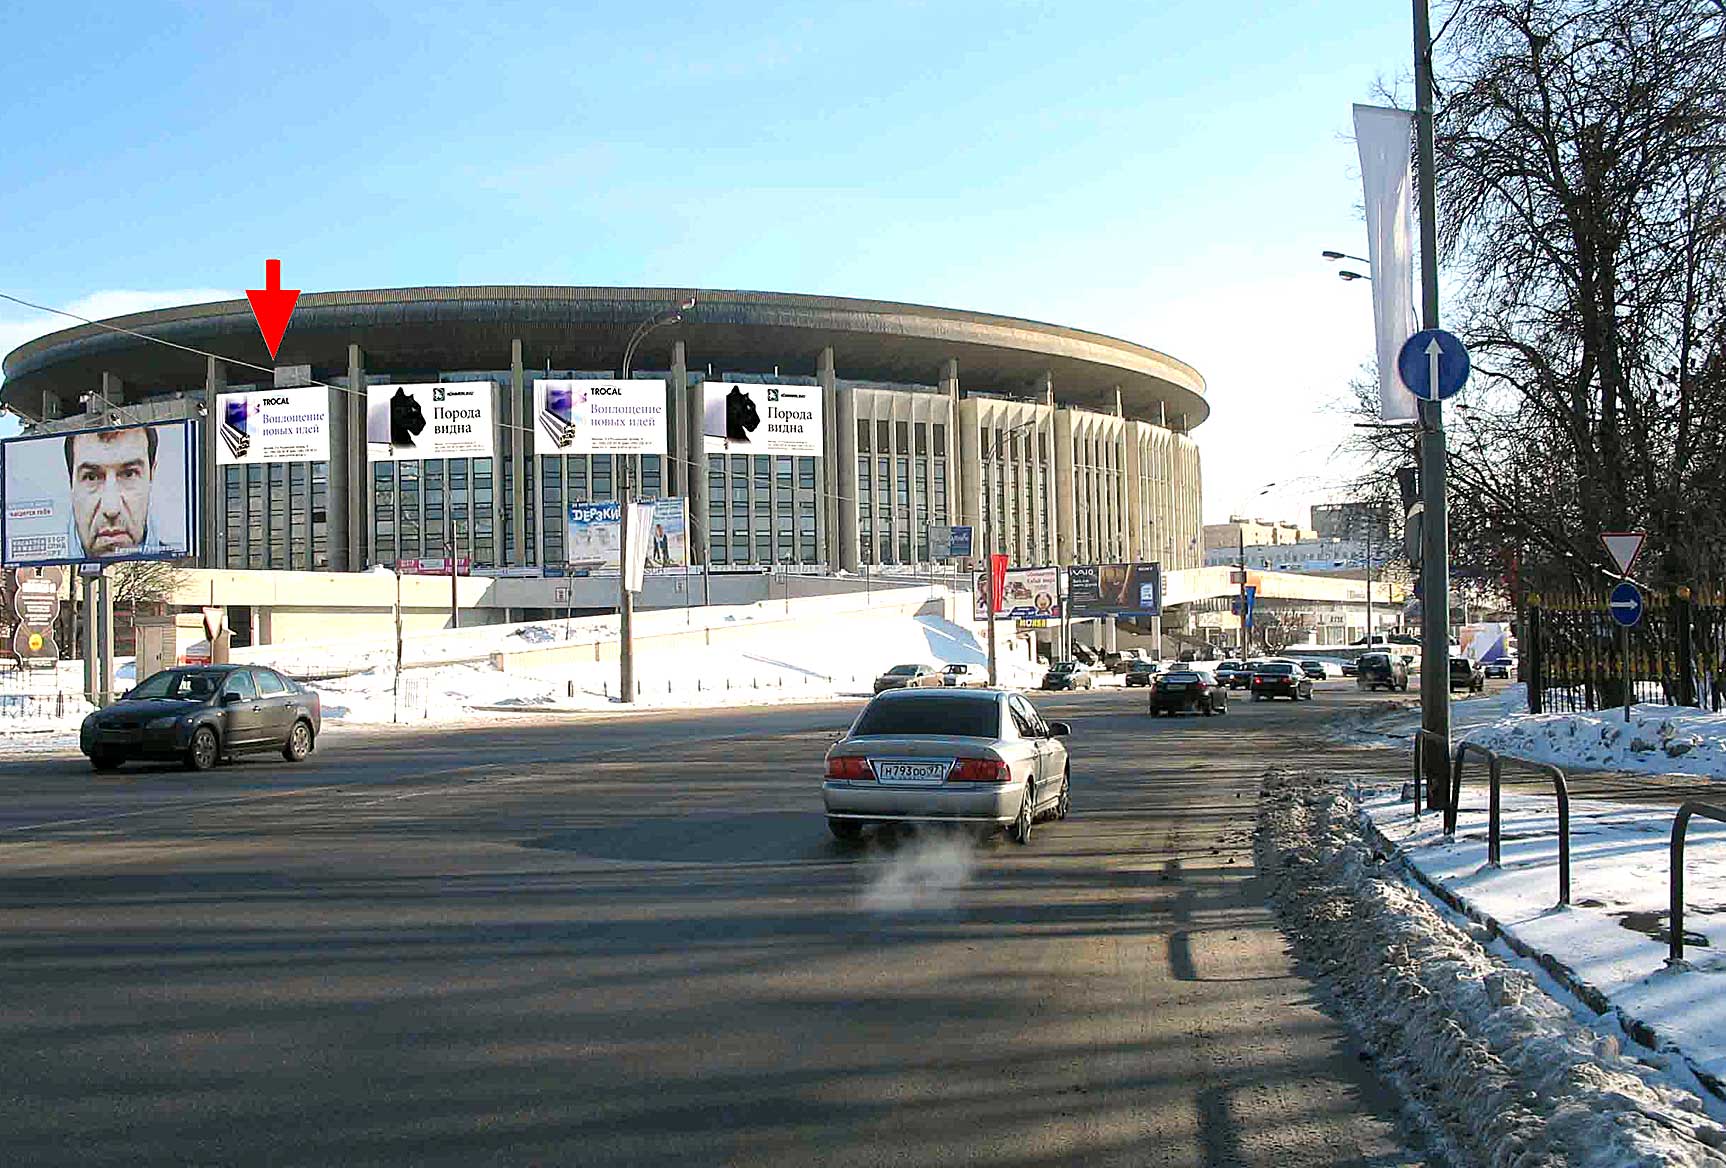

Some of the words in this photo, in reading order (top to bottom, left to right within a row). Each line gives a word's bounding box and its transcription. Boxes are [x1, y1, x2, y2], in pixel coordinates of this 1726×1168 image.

[590, 387, 622, 396] TROCAL
[262, 397, 290, 406] TROCAL
[591, 403, 662, 415] Воплощение
[768, 406, 813, 423] Порода
[262, 413, 325, 424] Воплощение
[434, 407, 481, 423] Порода
[591, 418, 626, 427] новых
[629, 416, 656, 427] идей
[262, 427, 293, 436] новых
[295, 424, 320, 435] идей
[434, 424, 472, 435] видна
[768, 423, 804, 434] видна
[1072, 568, 1094, 576] VAIO
